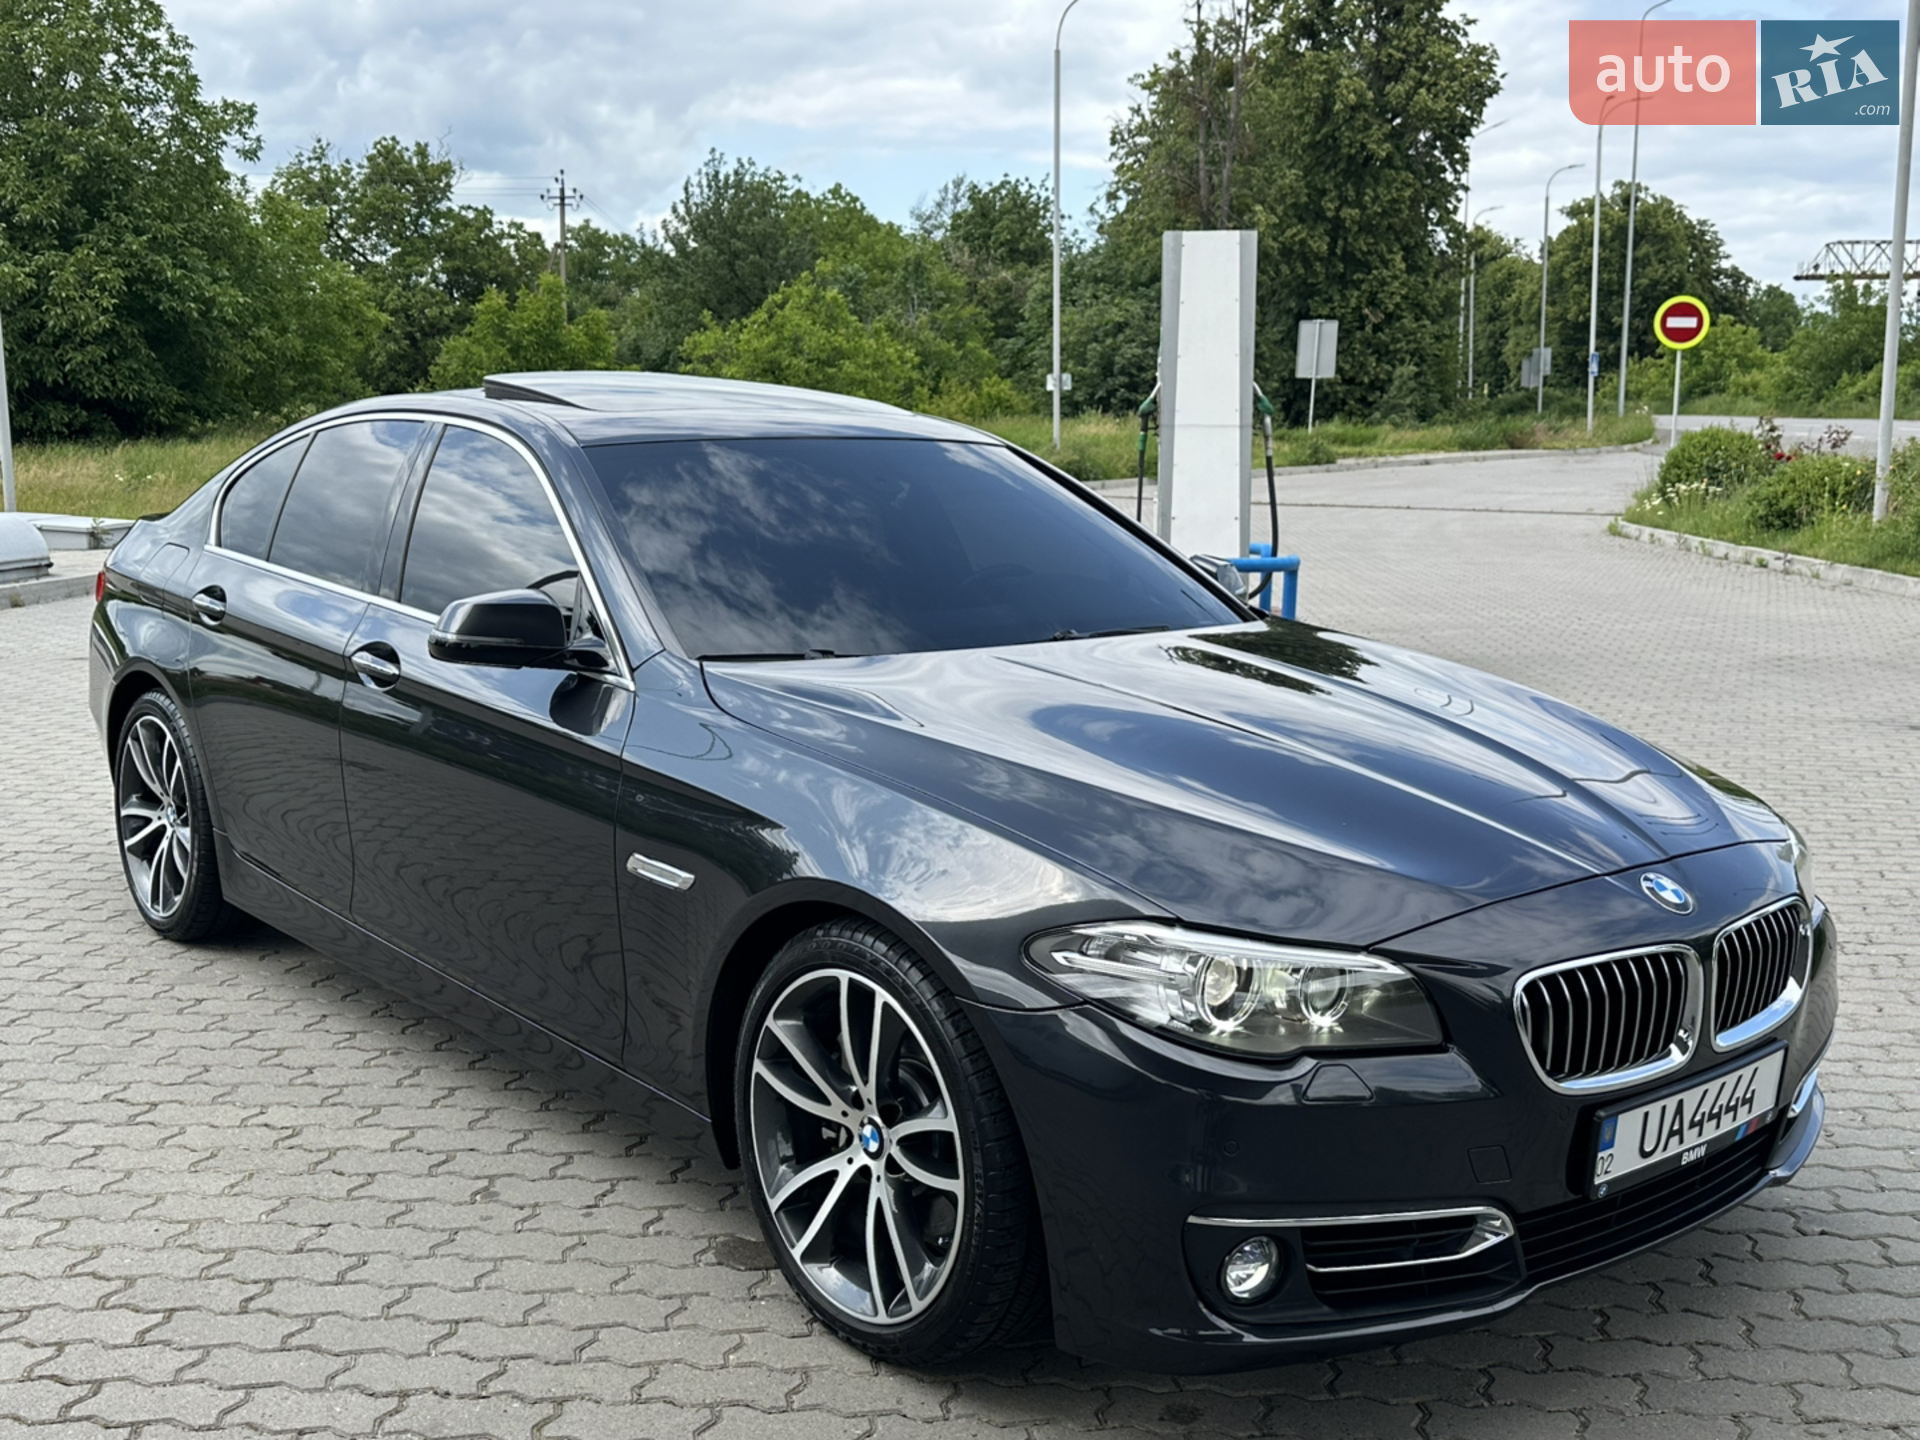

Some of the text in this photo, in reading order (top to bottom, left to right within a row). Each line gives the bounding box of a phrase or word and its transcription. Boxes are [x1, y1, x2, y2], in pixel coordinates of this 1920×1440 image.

[1638, 1066, 1759, 1160] UA4444
[1595, 1152, 1614, 1177] 02
[1680, 1143, 1708, 1165] BMW
